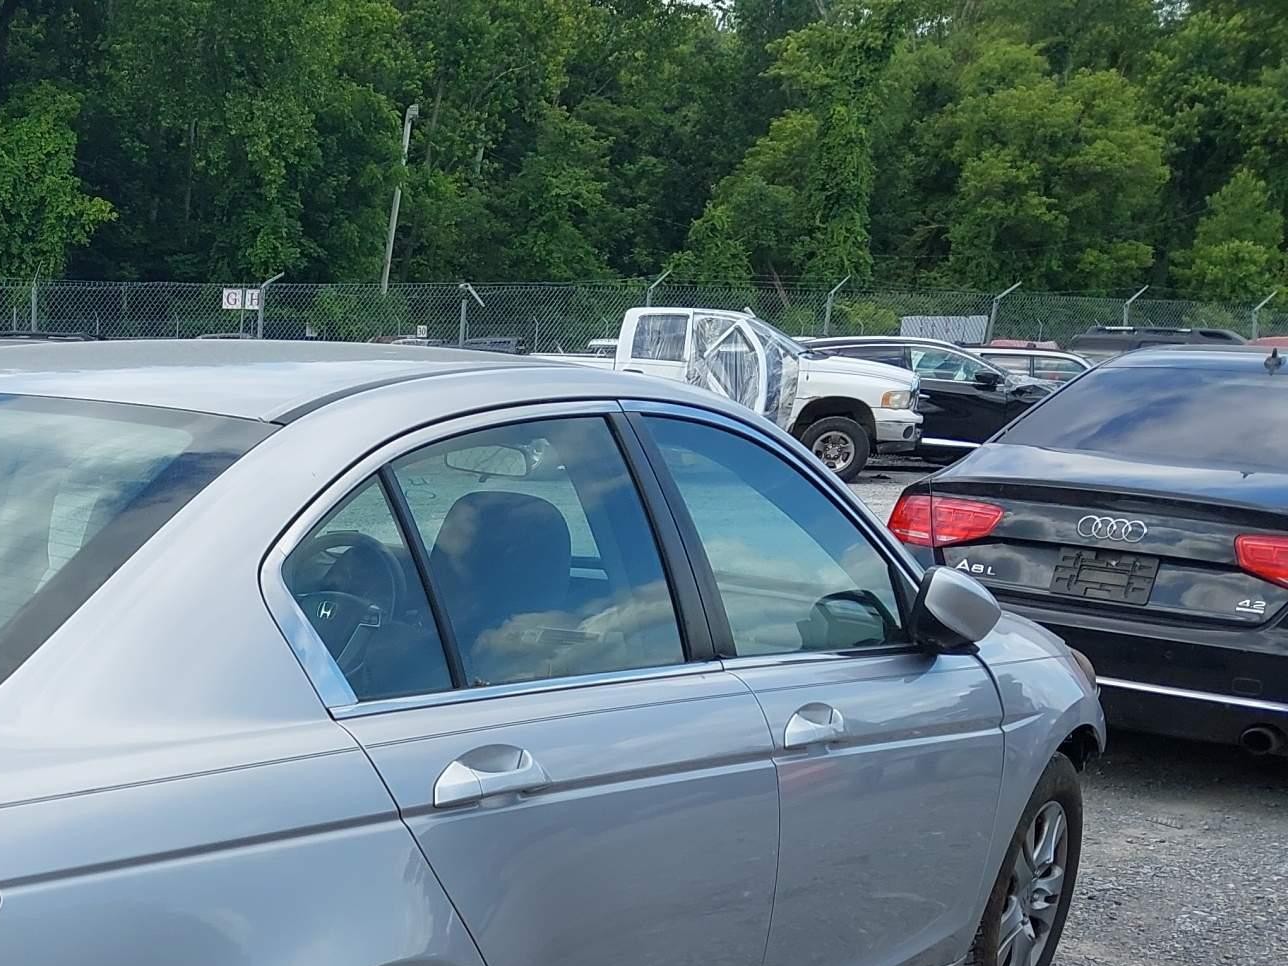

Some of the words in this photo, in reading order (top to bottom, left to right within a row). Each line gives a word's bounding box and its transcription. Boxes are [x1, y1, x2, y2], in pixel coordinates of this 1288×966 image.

[226, 291, 238, 306] G
[248, 292, 260, 306] H
[1238, 599, 1266, 610] 4.2
